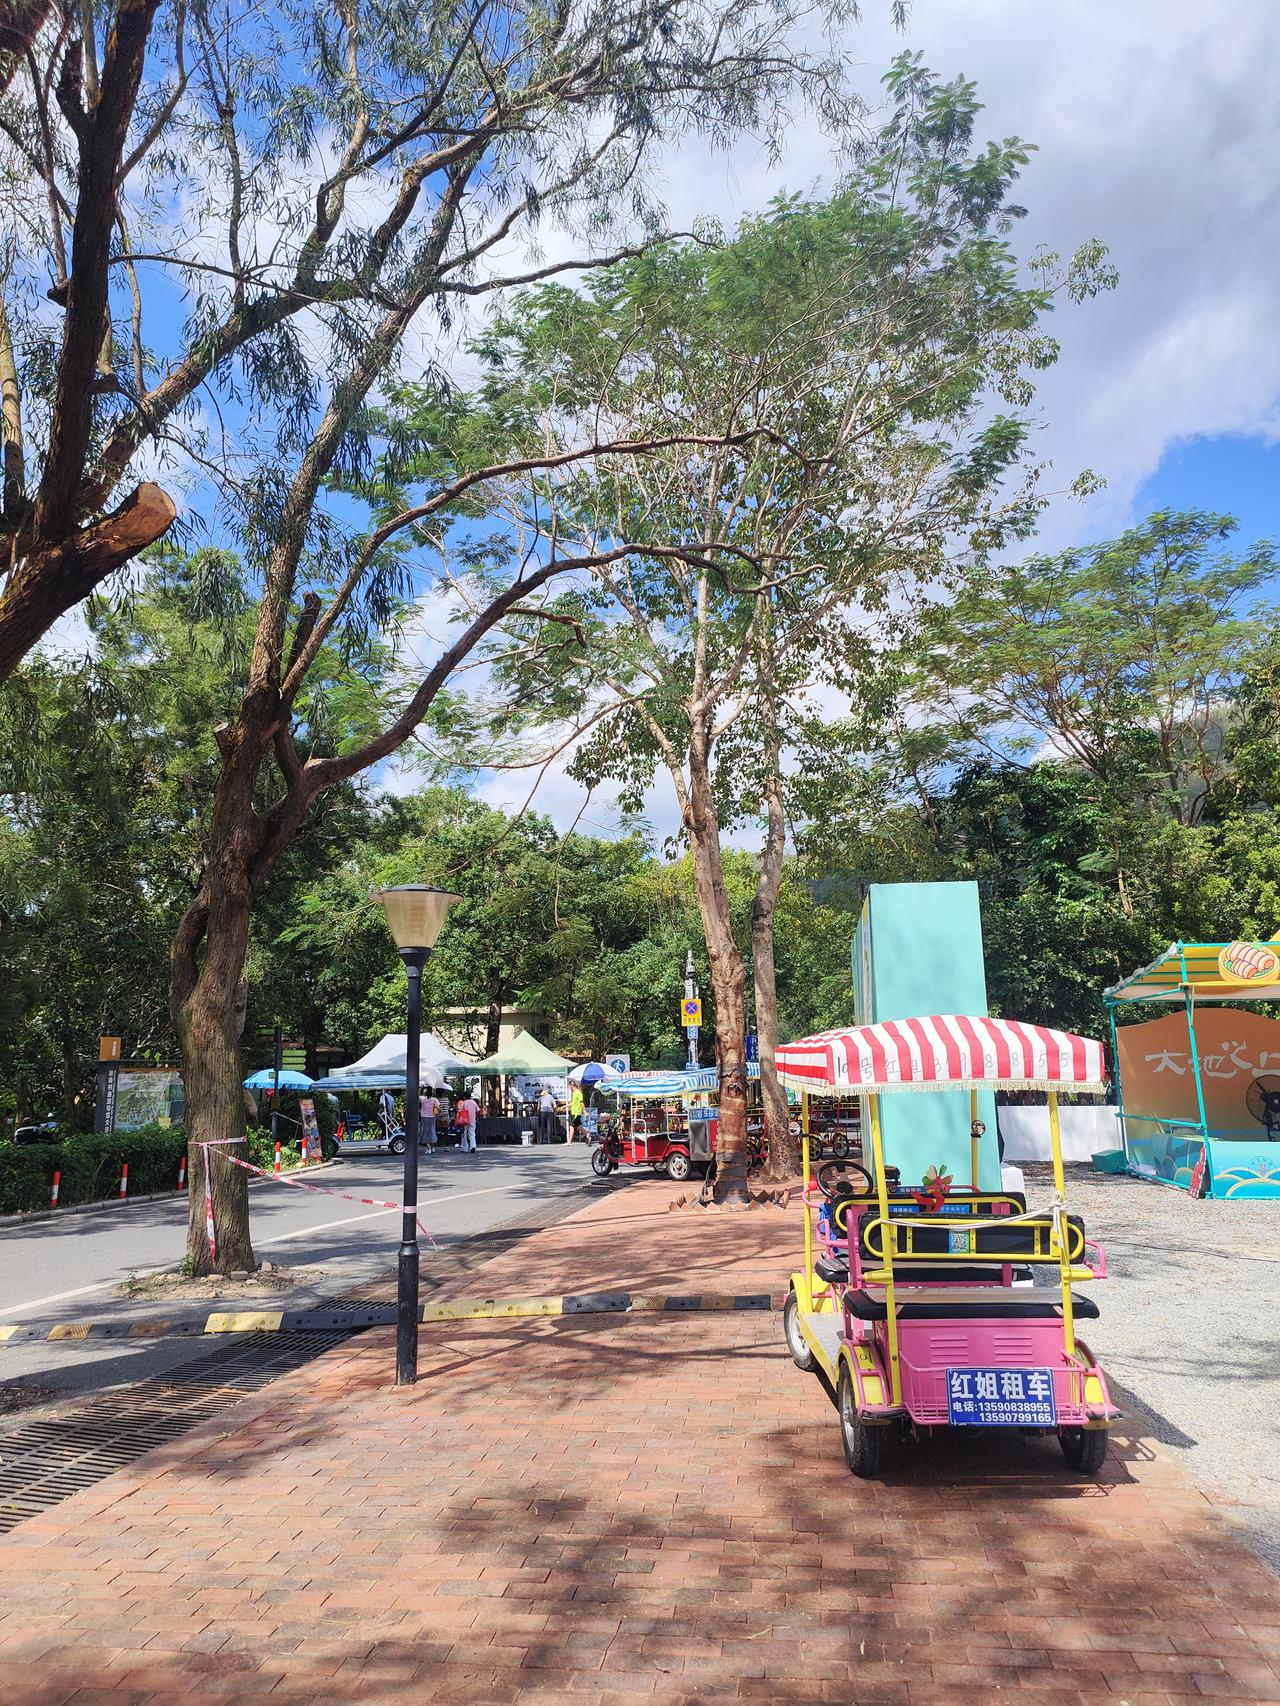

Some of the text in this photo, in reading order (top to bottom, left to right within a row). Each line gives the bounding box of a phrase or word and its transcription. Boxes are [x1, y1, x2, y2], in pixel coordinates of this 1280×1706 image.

[950, 1371, 1051, 1401] 红姐租车
[979, 1413, 1052, 1422] 13590799165
